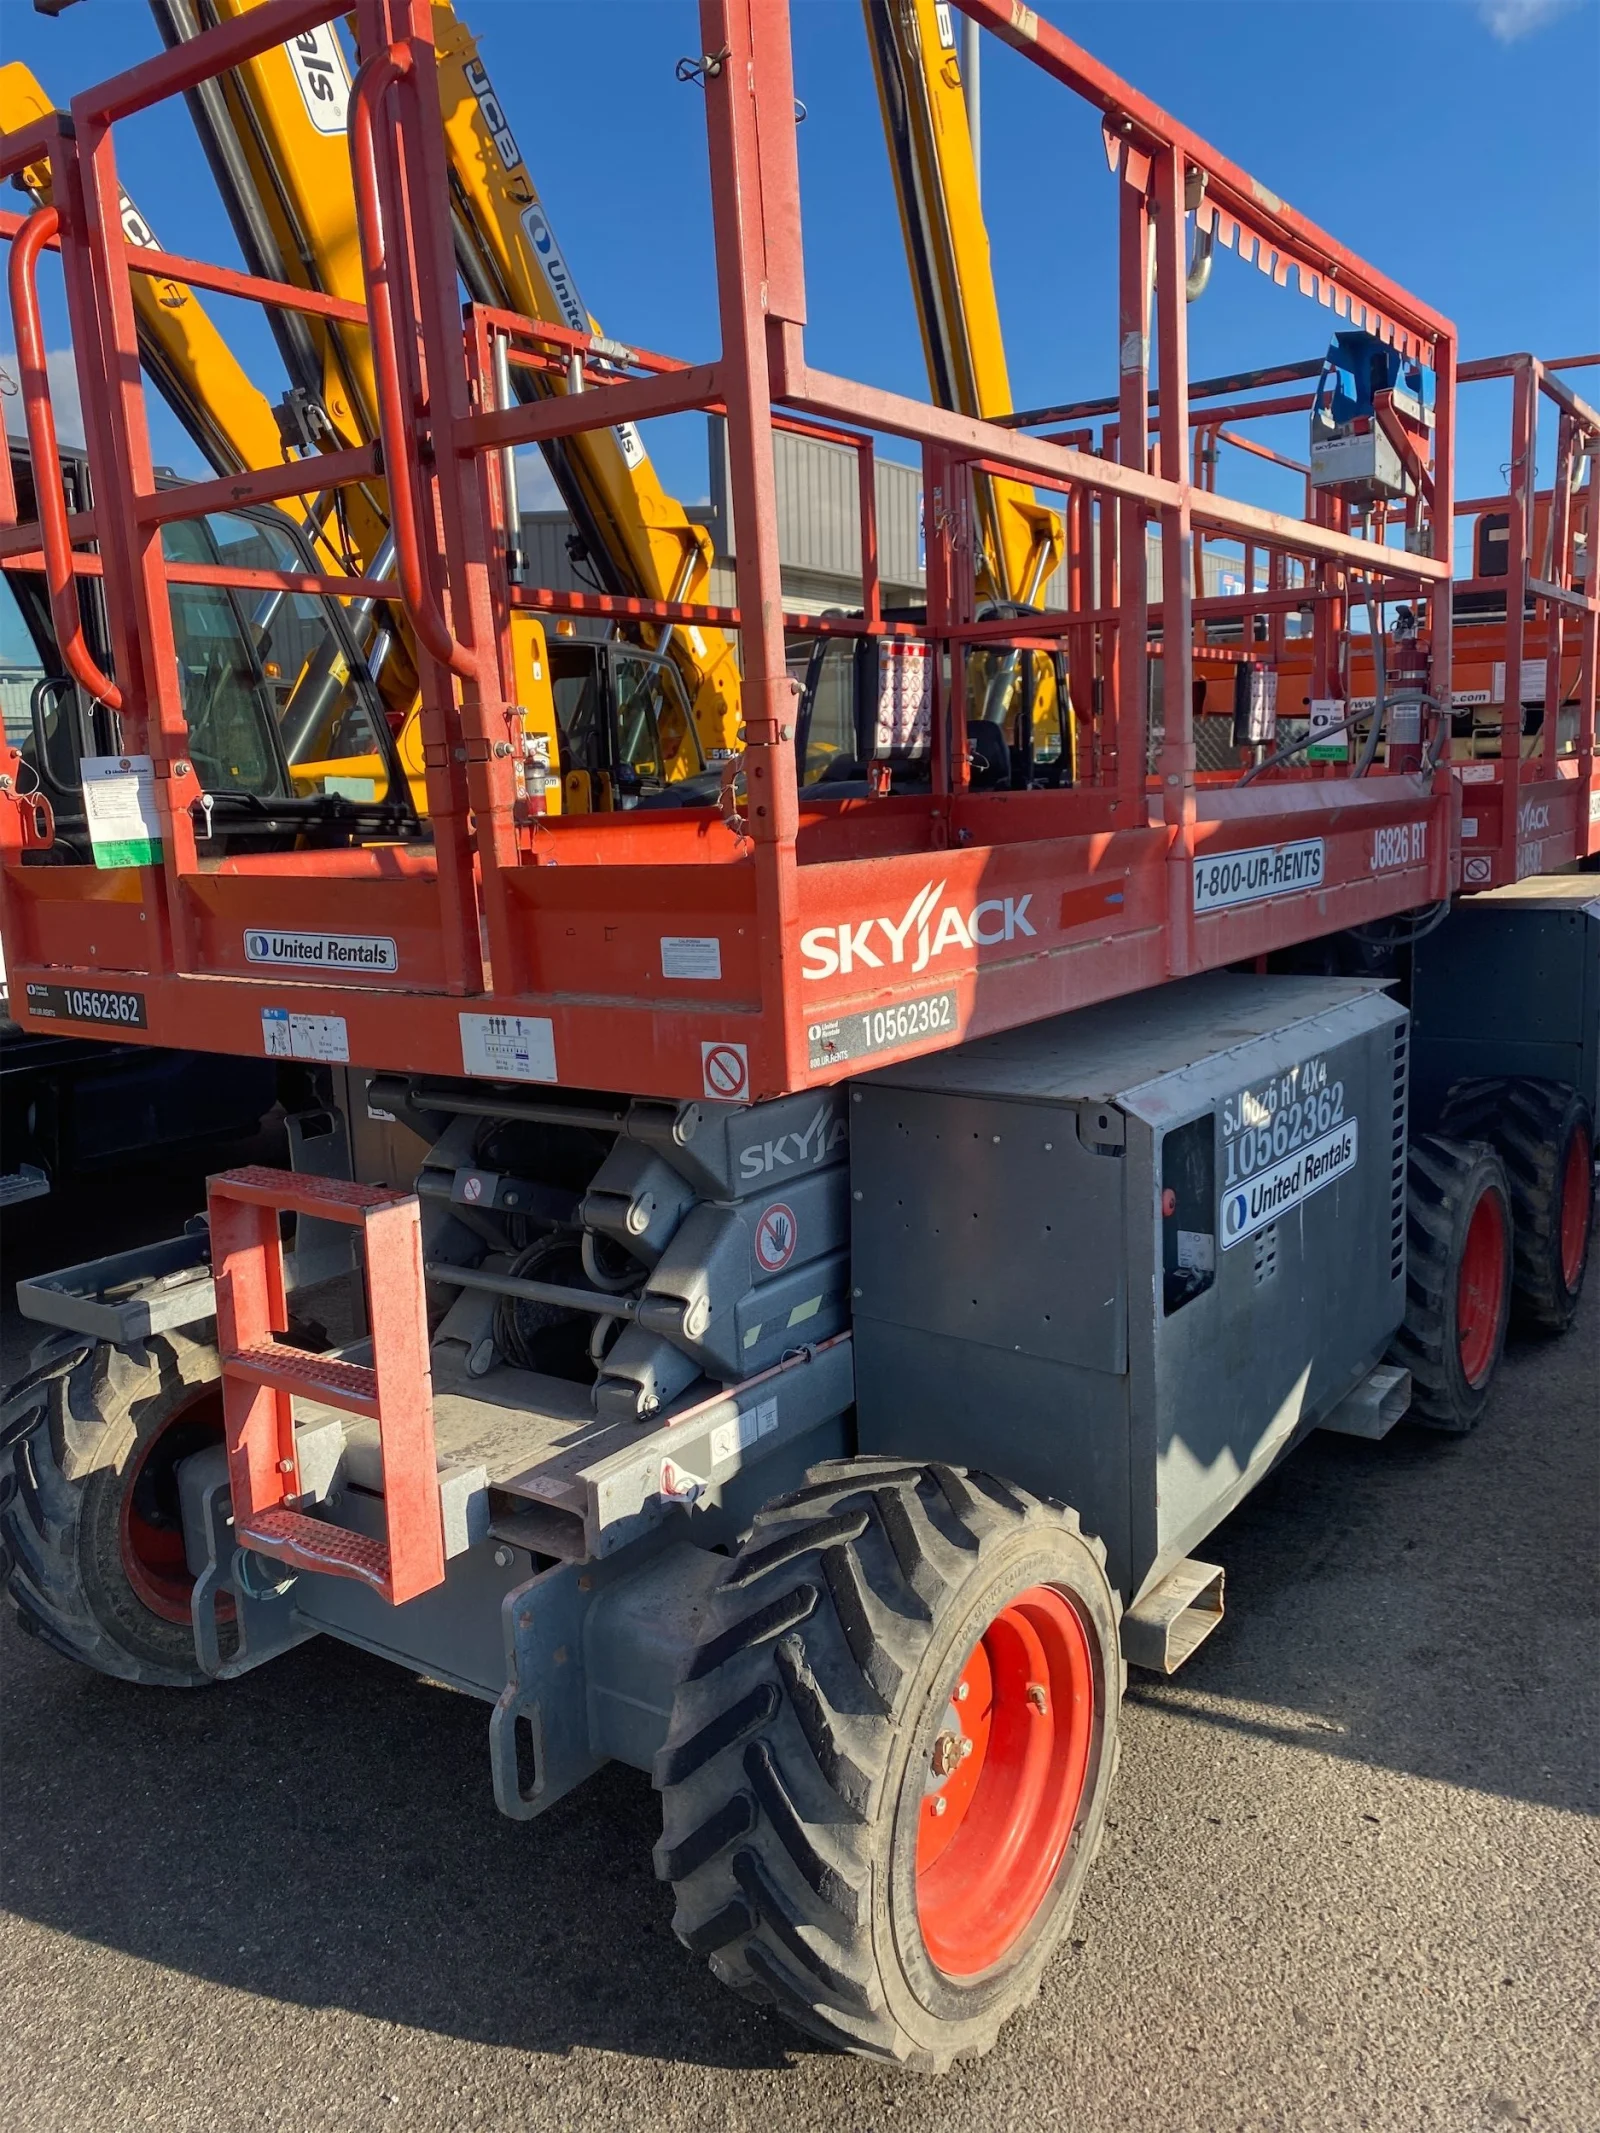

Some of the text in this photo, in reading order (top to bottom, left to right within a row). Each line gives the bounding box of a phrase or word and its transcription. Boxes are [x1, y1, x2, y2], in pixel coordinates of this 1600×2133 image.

[465, 64, 519, 168] JCB
[1411, 821, 1428, 860] RT
[1195, 847, 1321, 899] 1-800-UR-RENTS
[272, 938, 387, 964] United Rentals
[800, 878, 1037, 980] SKYJACK
[64, 990, 140, 1021] 10562362
[821, 1020, 839, 1031] United
[862, 995, 951, 1046] 10562362
[1281, 1065, 1300, 1107] RT
[1302, 1059, 1328, 1095] 4X4
[1224, 1081, 1344, 1186] 10562362
[1251, 1133, 1352, 1219] United Rentals
